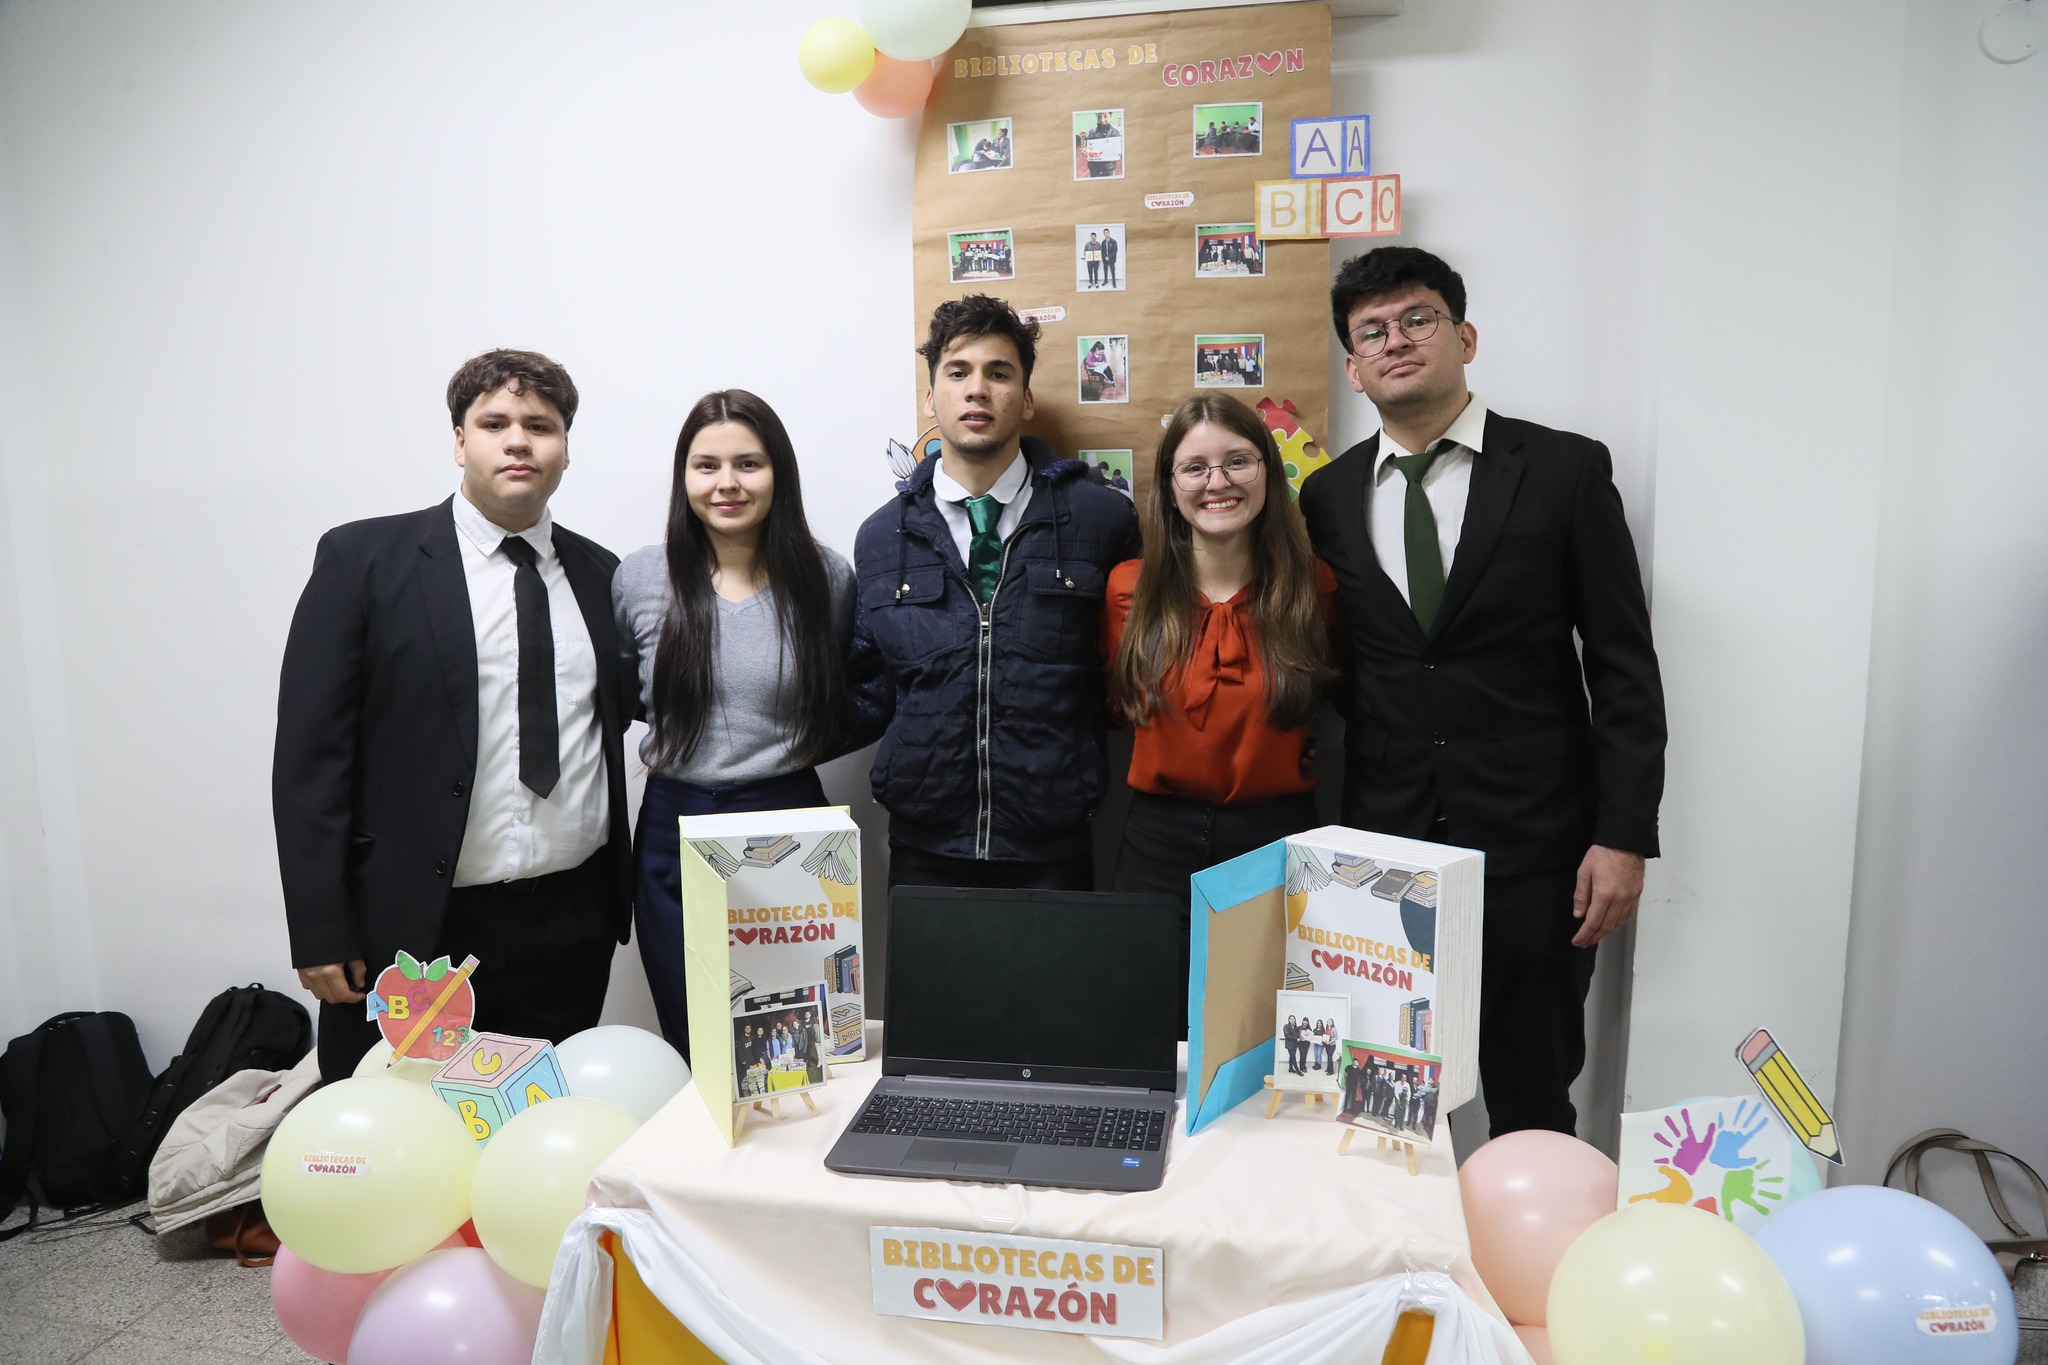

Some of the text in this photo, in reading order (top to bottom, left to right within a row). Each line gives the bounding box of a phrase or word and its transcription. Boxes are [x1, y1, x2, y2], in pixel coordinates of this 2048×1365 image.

[955, 43, 1158, 78] BIBLIOTECAS DE
[1301, 128, 1336, 168] A
[1348, 126, 1363, 167] A
[1271, 190, 1297, 228] B
[1335, 188, 1364, 225] C
[1379, 186, 1394, 223] C
[728, 902, 855, 924] BLIOTECAS DE
[1297, 923, 1431, 972] BIBLIOTECAS DE
[432, 1026, 470, 1047] 123
[457, 1100, 491, 1141] B
[303, 1154, 355, 1164] BIBLIOTECAS
[883, 1238, 1155, 1286] BIBLIOTECAS DE
